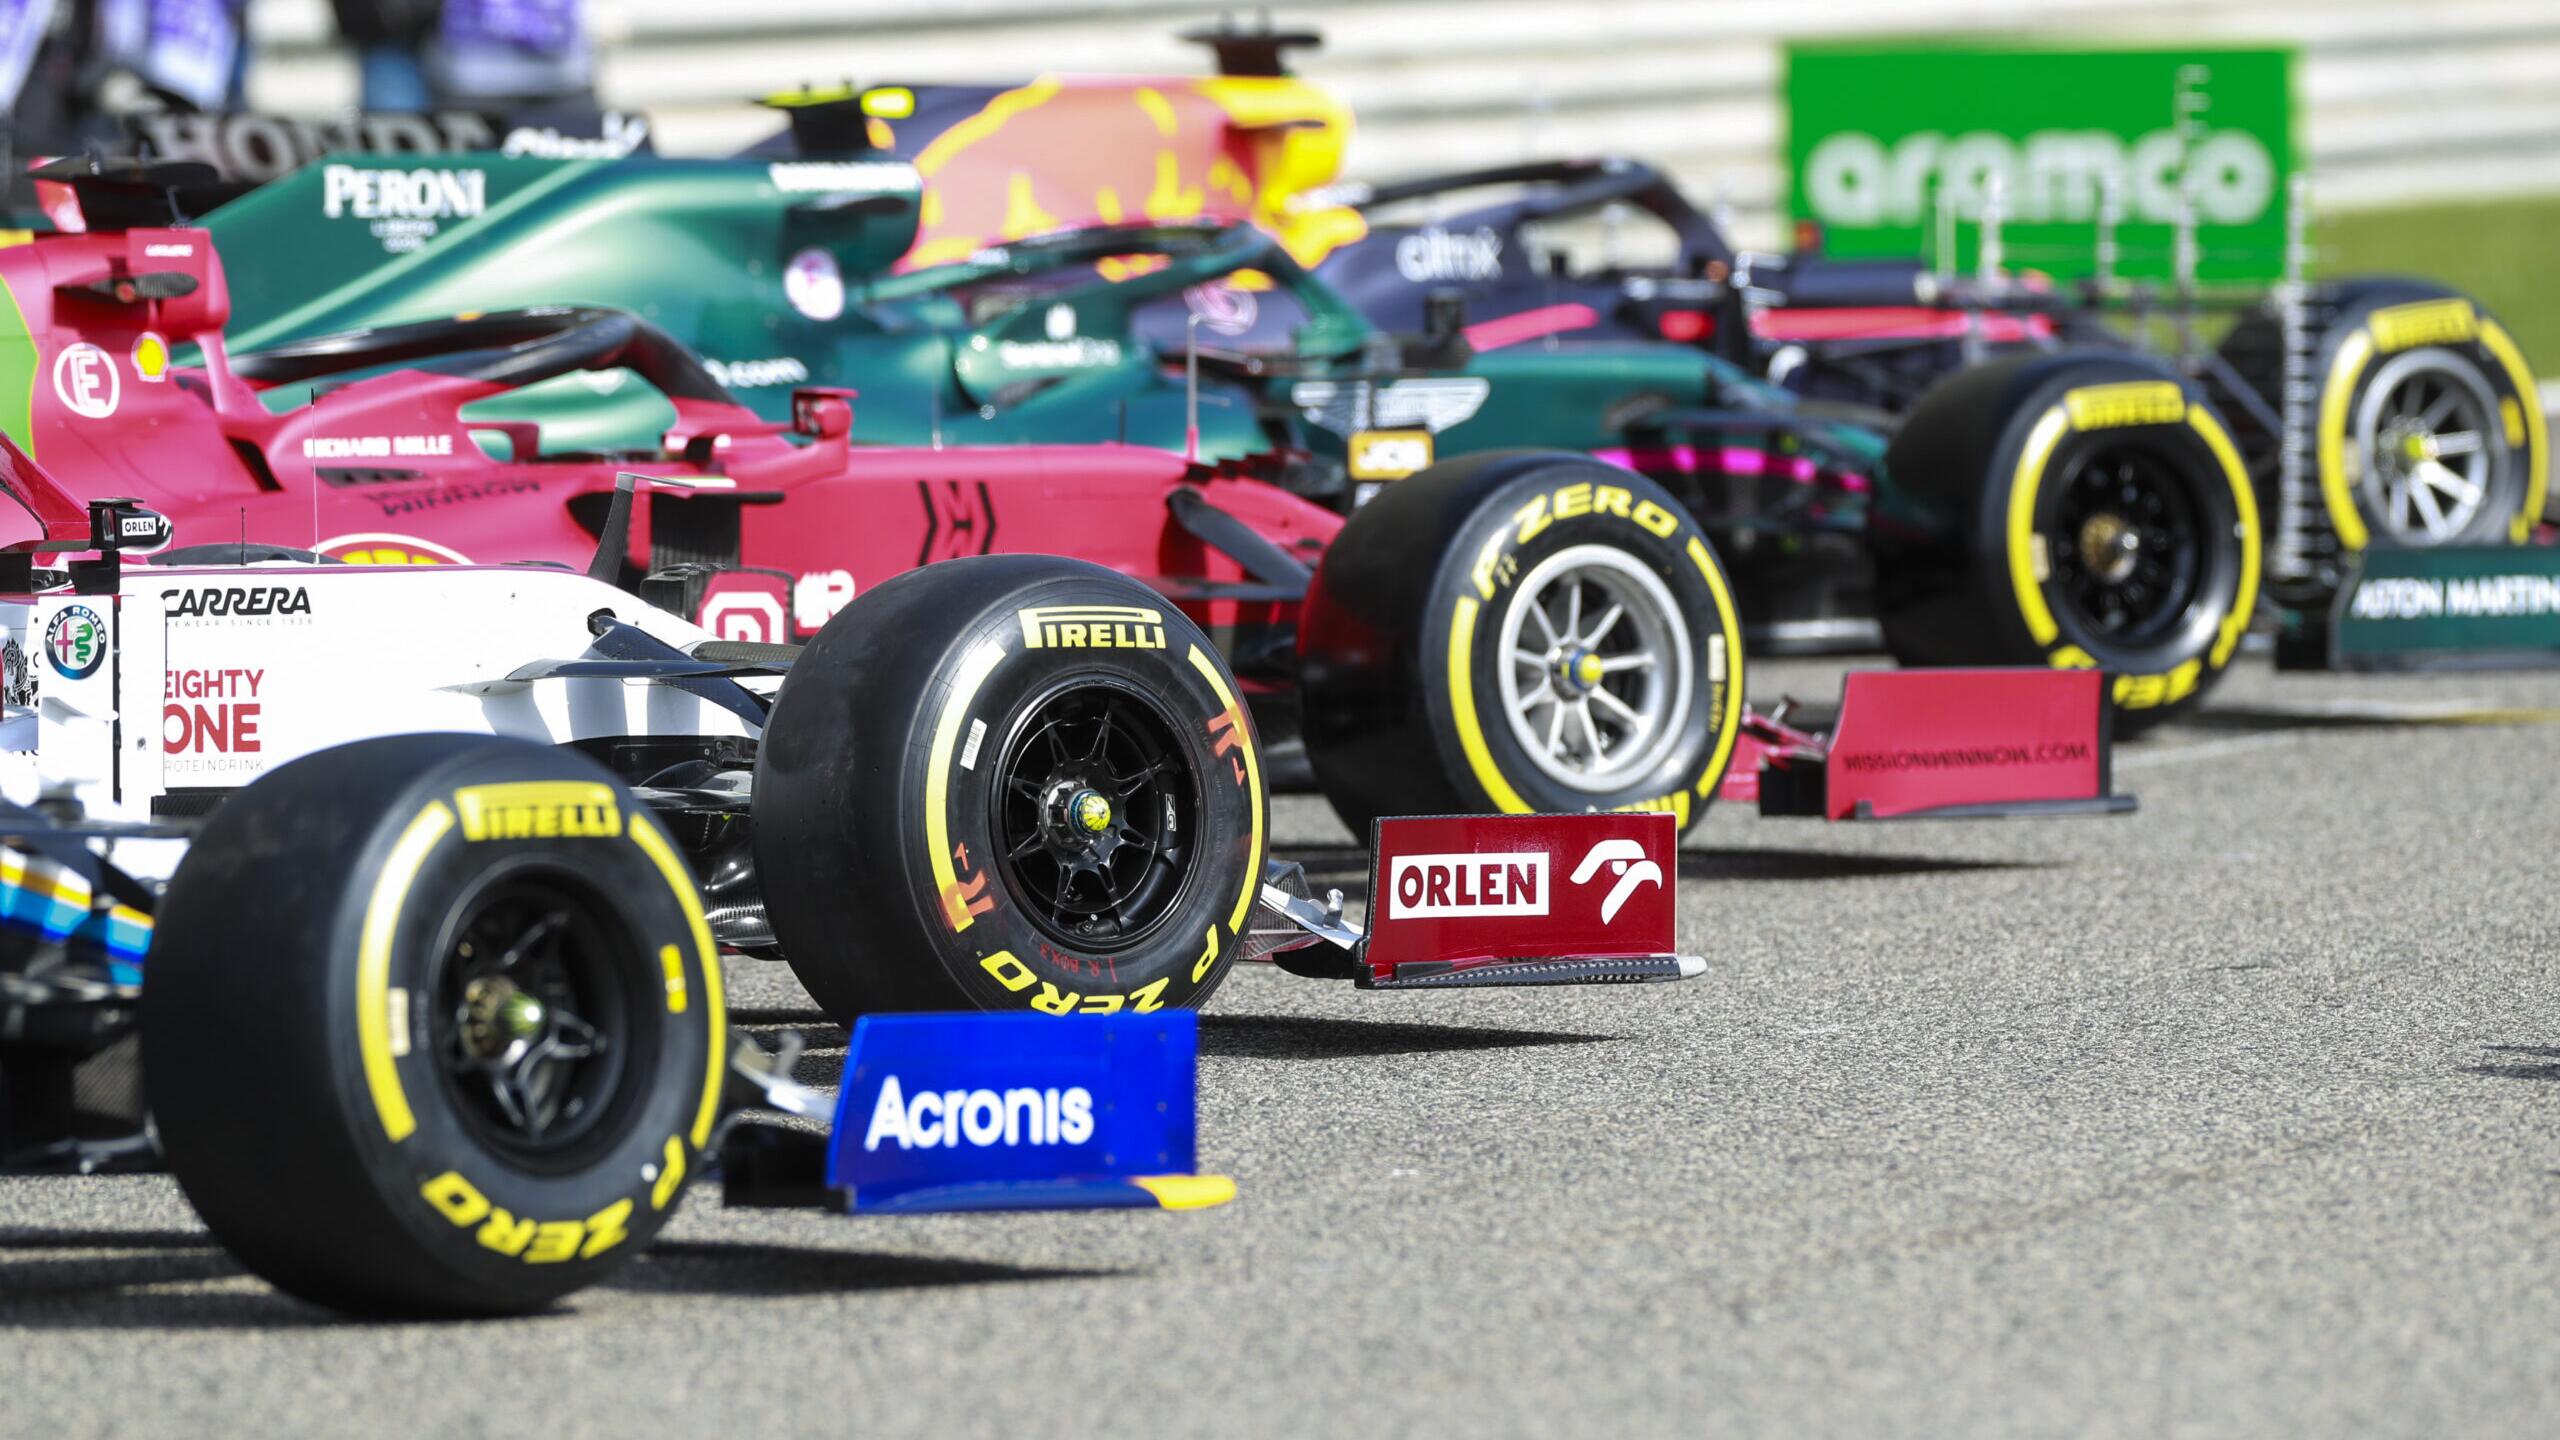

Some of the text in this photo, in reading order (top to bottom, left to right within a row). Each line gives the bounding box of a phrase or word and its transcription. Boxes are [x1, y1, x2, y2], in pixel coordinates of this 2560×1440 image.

[322, 164, 486, 218] PERONI
[1804, 128, 2276, 226] aramco
[124, 521, 154, 533] ORLEN
[1512, 482, 1680, 545] ZERO
[46, 606, 107, 644] ALFA ROMEO
[160, 586, 311, 617] CARRERA
[1018, 605, 1166, 649] PIRELLI
[165, 669, 264, 699] EIGHTY
[163, 703, 261, 754] ONE
[164, 758, 264, 774] ROTEINDRINK
[454, 780, 622, 842] PIRELLI
[1398, 862, 1537, 908] ORLEN
[979, 924, 1219, 1017] P ZERO
[864, 1074, 1094, 1151] Acronis
[419, 1170, 634, 1264] ZERO
